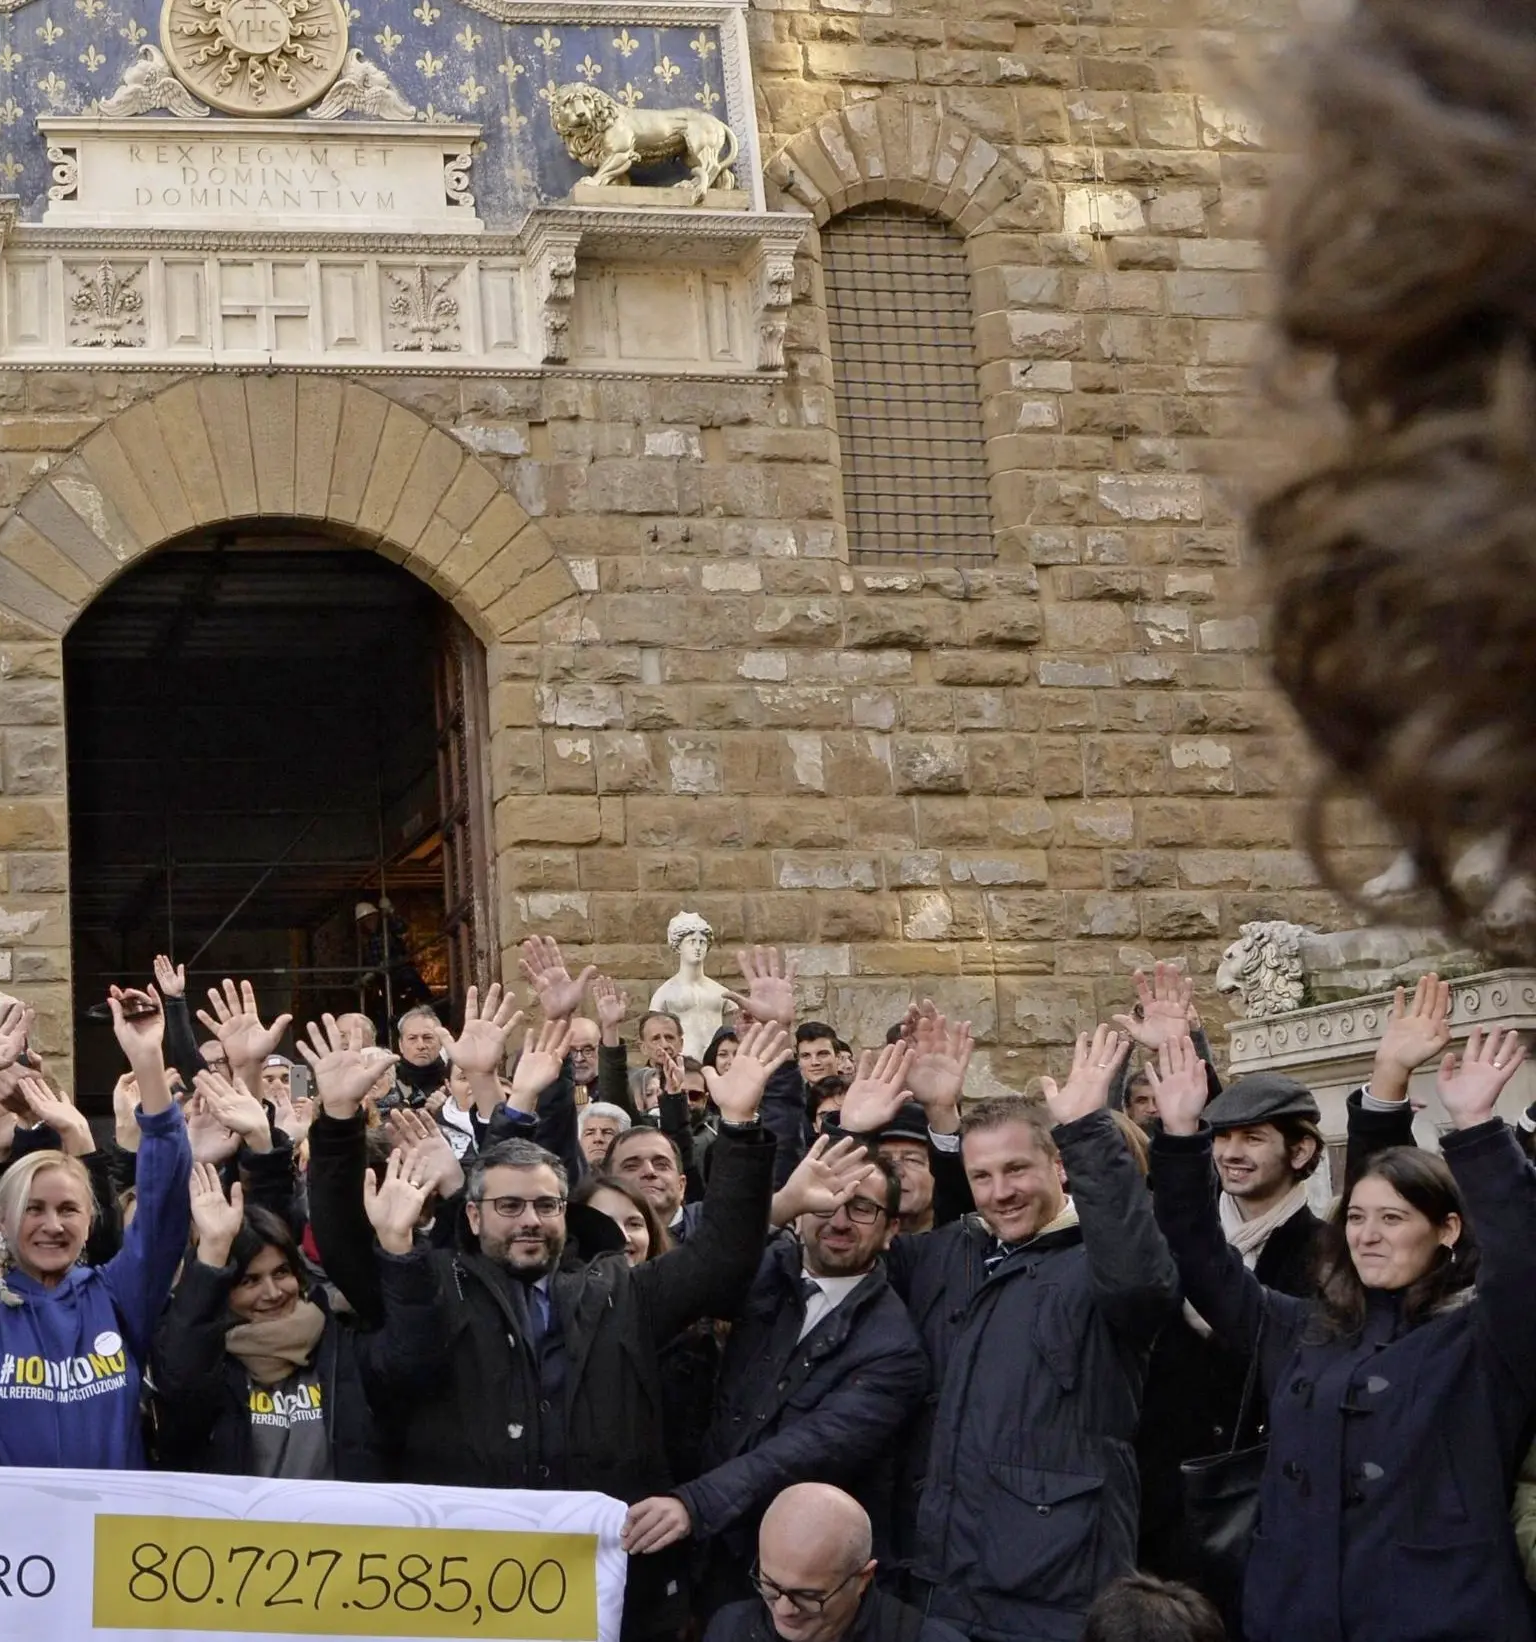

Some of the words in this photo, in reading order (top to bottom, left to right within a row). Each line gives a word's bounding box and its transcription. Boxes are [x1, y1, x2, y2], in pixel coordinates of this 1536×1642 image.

[128, 145, 193, 164] REX
[211, 146, 329, 167] REGVM
[354, 147, 395, 167] ET
[182, 166, 342, 187] DOMINVS
[135, 187, 396, 210] DOMINANTIVM
[128, 1542, 567, 1625] 80.727.585,00
